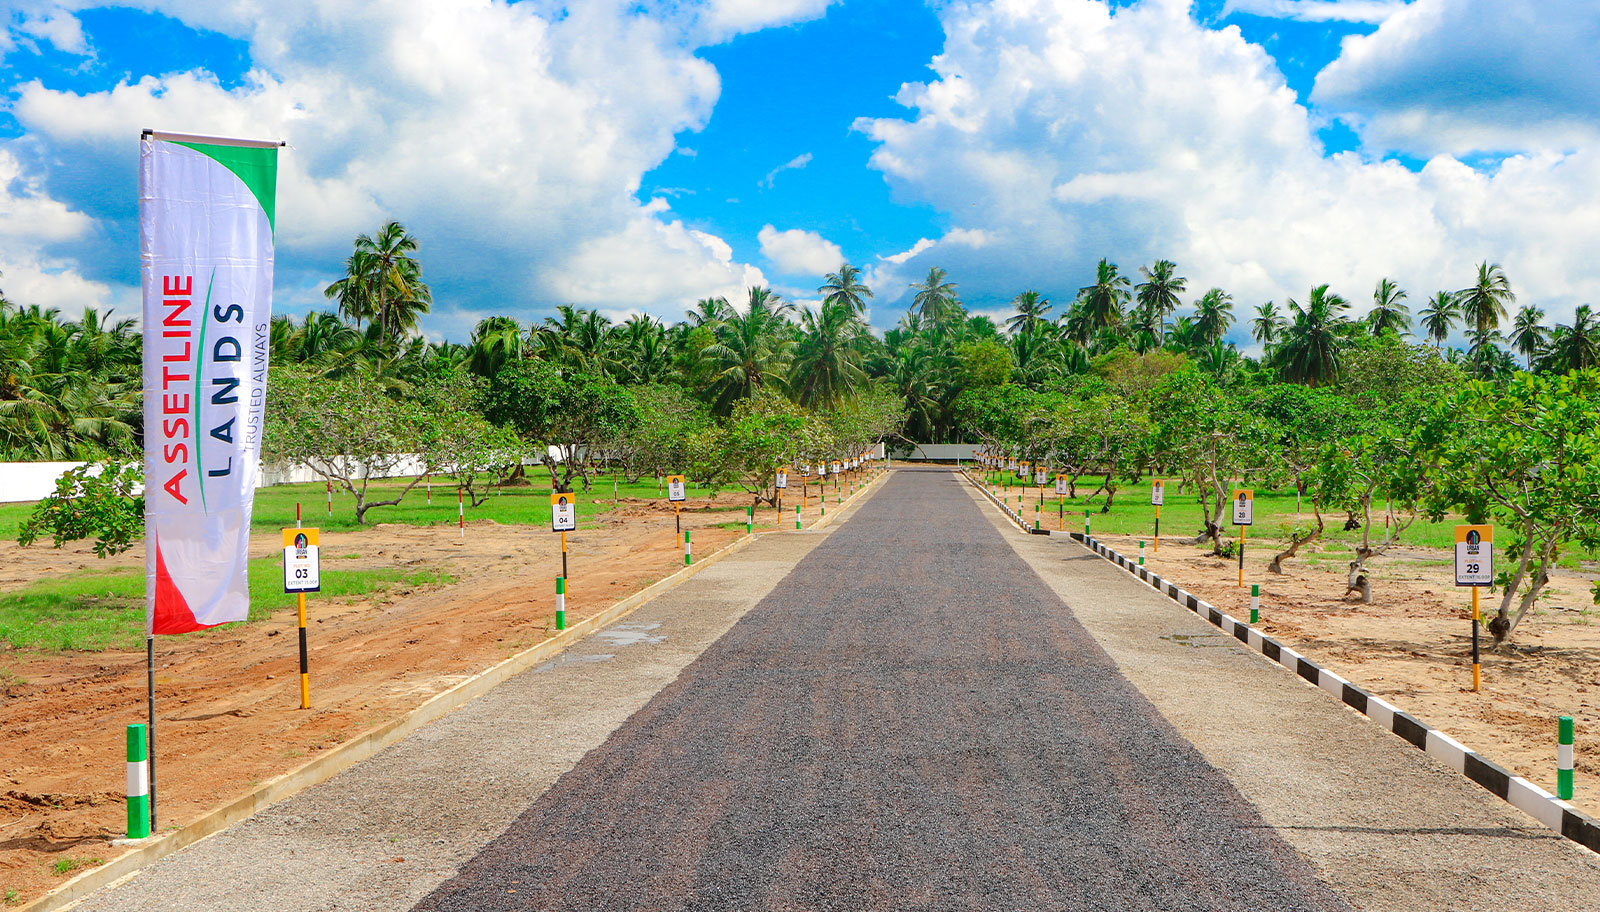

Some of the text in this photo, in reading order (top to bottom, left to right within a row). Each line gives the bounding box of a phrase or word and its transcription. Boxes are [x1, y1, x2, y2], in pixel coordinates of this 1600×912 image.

[162, 275, 193, 505] ASSETLINE
[207, 303, 245, 478] LANDS
[244, 322, 267, 452] TRUSTED ALWAYS
[295, 569, 308, 578] 03
[1466, 564, 1479, 573] 29
